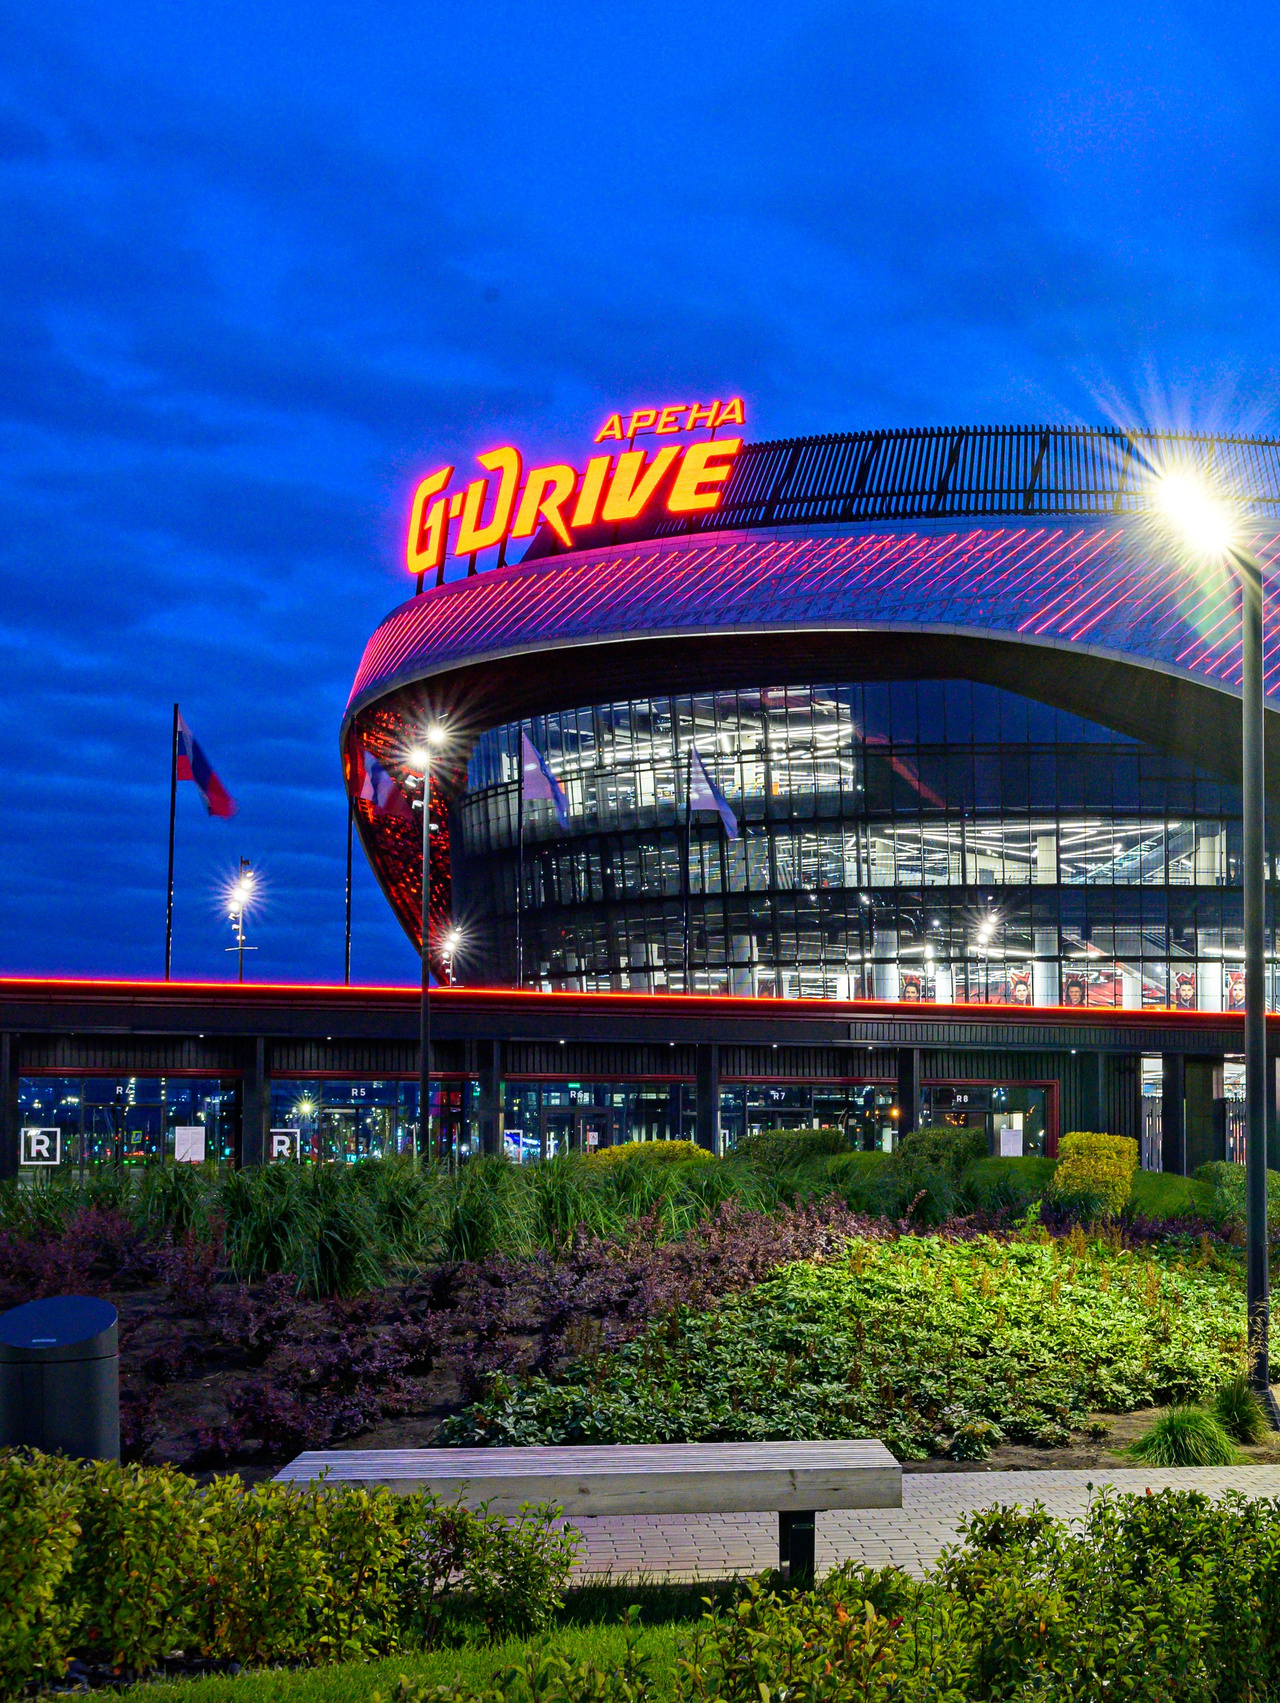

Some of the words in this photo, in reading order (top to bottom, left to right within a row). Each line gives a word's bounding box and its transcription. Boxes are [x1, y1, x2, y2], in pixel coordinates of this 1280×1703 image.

[594, 398, 746, 443] АРЕНА
[31, 1135, 50, 1157] R
[272, 1135, 290, 1157] R
